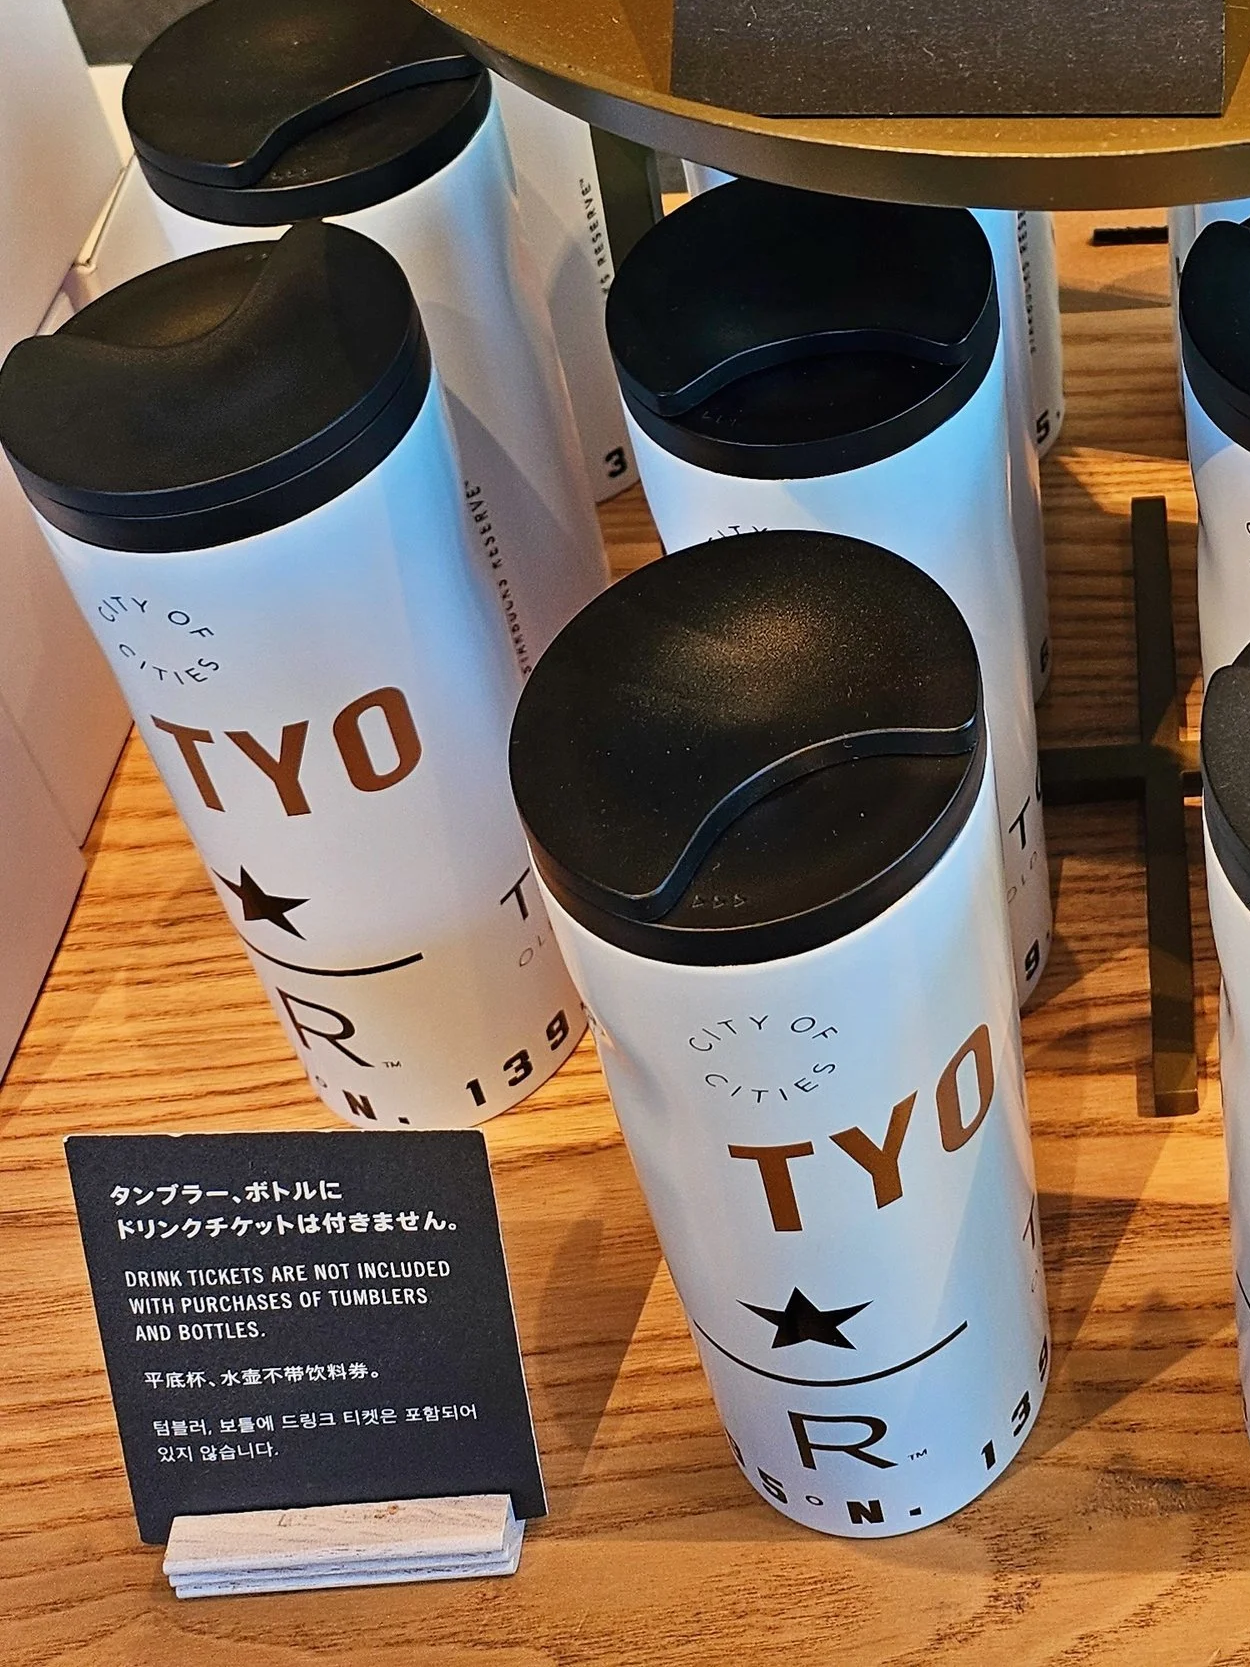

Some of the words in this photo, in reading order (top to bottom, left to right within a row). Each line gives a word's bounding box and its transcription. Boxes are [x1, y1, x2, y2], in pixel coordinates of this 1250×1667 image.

[98, 595, 148, 624] CITY
[167, 609, 214, 640] OF
[119, 643, 221, 686] CITIES
[149, 686, 423, 818] TYO
[688, 1014, 771, 1054] CITY
[790, 1015, 839, 1043] OF
[704, 1061, 837, 1106] CITIES
[727, 1023, 996, 1233] TYO
[110, 1180, 343, 1207] タンブラー、ボトルに
[117, 1211, 459, 1241] ドリンクチケットは付きません。
[124, 1268, 183, 1289] DRINK
[188, 1266, 264, 1287] TICKETS
[271, 1264, 306, 1284] ARE
[314, 1262, 350, 1282] NOT
[357, 1260, 451, 1280] INCLUDED
[129, 1297, 175, 1316] WITH
[181, 1292, 293, 1314] PURCHASES
[299, 1290, 322, 1308] OF
[327, 1287, 429, 1308] TUMBLERS
[135, 1324, 172, 1343] AND
[178, 1321, 267, 1341] BOTTLES.
[152, 1418, 213, 1437] 텀블러,
[219, 1415, 275, 1434] 보틀에
[281, 1412, 337, 1431] 드링크
[343, 1408, 398, 1427] 티켓은
[405, 1404, 479, 1424] 포함되어
[157, 1445, 194, 1464] 있지
[200, 1440, 280, 1462] 않습니다.
